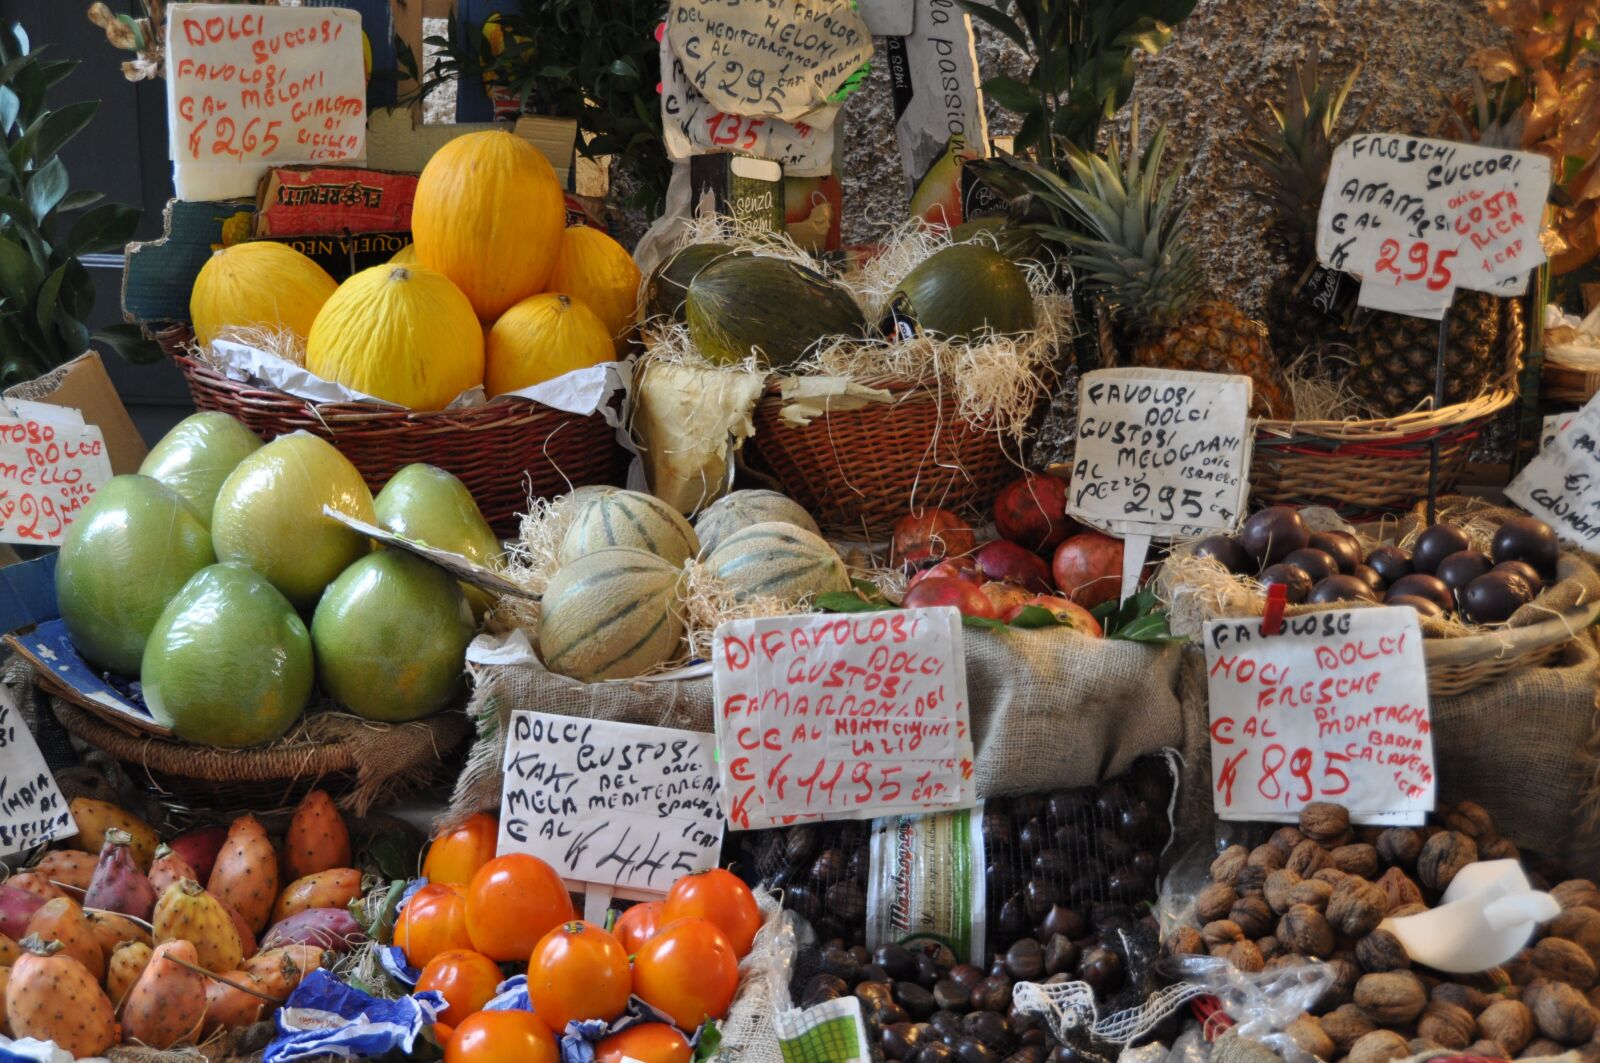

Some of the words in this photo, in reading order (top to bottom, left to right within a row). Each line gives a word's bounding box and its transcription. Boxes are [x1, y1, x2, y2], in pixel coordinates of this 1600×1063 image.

[183, 14, 264, 46] DOLCI
[678, 7, 704, 24] DEL
[252, 20, 343, 65] SUCCOSI
[712, 40, 731, 57] AL
[765, 14, 838, 60] MELONI
[178, 59, 286, 87] FAVOLOSI
[892, 56, 908, 89] semi
[241, 70, 324, 110] MELONI
[928, 37, 968, 167] passione
[203, 95, 228, 116] AL
[324, 117, 341, 130] DI
[297, 129, 358, 149] SICILIA
[736, 191, 773, 215] senza
[1455, 191, 1517, 235] COSTA
[1354, 213, 1381, 231] AL
[1470, 212, 1525, 251] RICA
[1088, 383, 1195, 407] FAVOLOSI
[1145, 401, 1213, 427] DOLCI
[1080, 417, 1177, 449] GUSTOSI
[25, 440, 102, 466] DOLCE
[1117, 436, 1239, 469] MELOGRANI
[1075, 460, 1103, 480] AL
[760, 614, 919, 663] FAVOLOSI
[1314, 633, 1406, 671] DOLCI
[868, 645, 945, 676] DOLCI
[1210, 655, 1290, 686] NOCI
[786, 656, 912, 699] GUSTOSI
[1257, 671, 1382, 713] FRESCHE
[914, 685, 945, 717] DEI
[515, 716, 592, 744] DOLCI
[791, 723, 823, 744] AL
[835, 718, 889, 736] MONTI
[1243, 716, 1277, 738] AL
[1319, 704, 1431, 738] MONTAGNA
[852, 735, 922, 756] LAZIO
[1369, 731, 1422, 750] BADIA
[577, 740, 700, 772] GUSTOSI
[508, 751, 579, 794] KAKI
[600, 774, 639, 792] DEL
[1258, 743, 1351, 810] 8,95
[2, 773, 49, 817] INDIA
[40, 792, 57, 813] DI
[507, 788, 577, 816] MELA
[540, 818, 572, 840] AL
